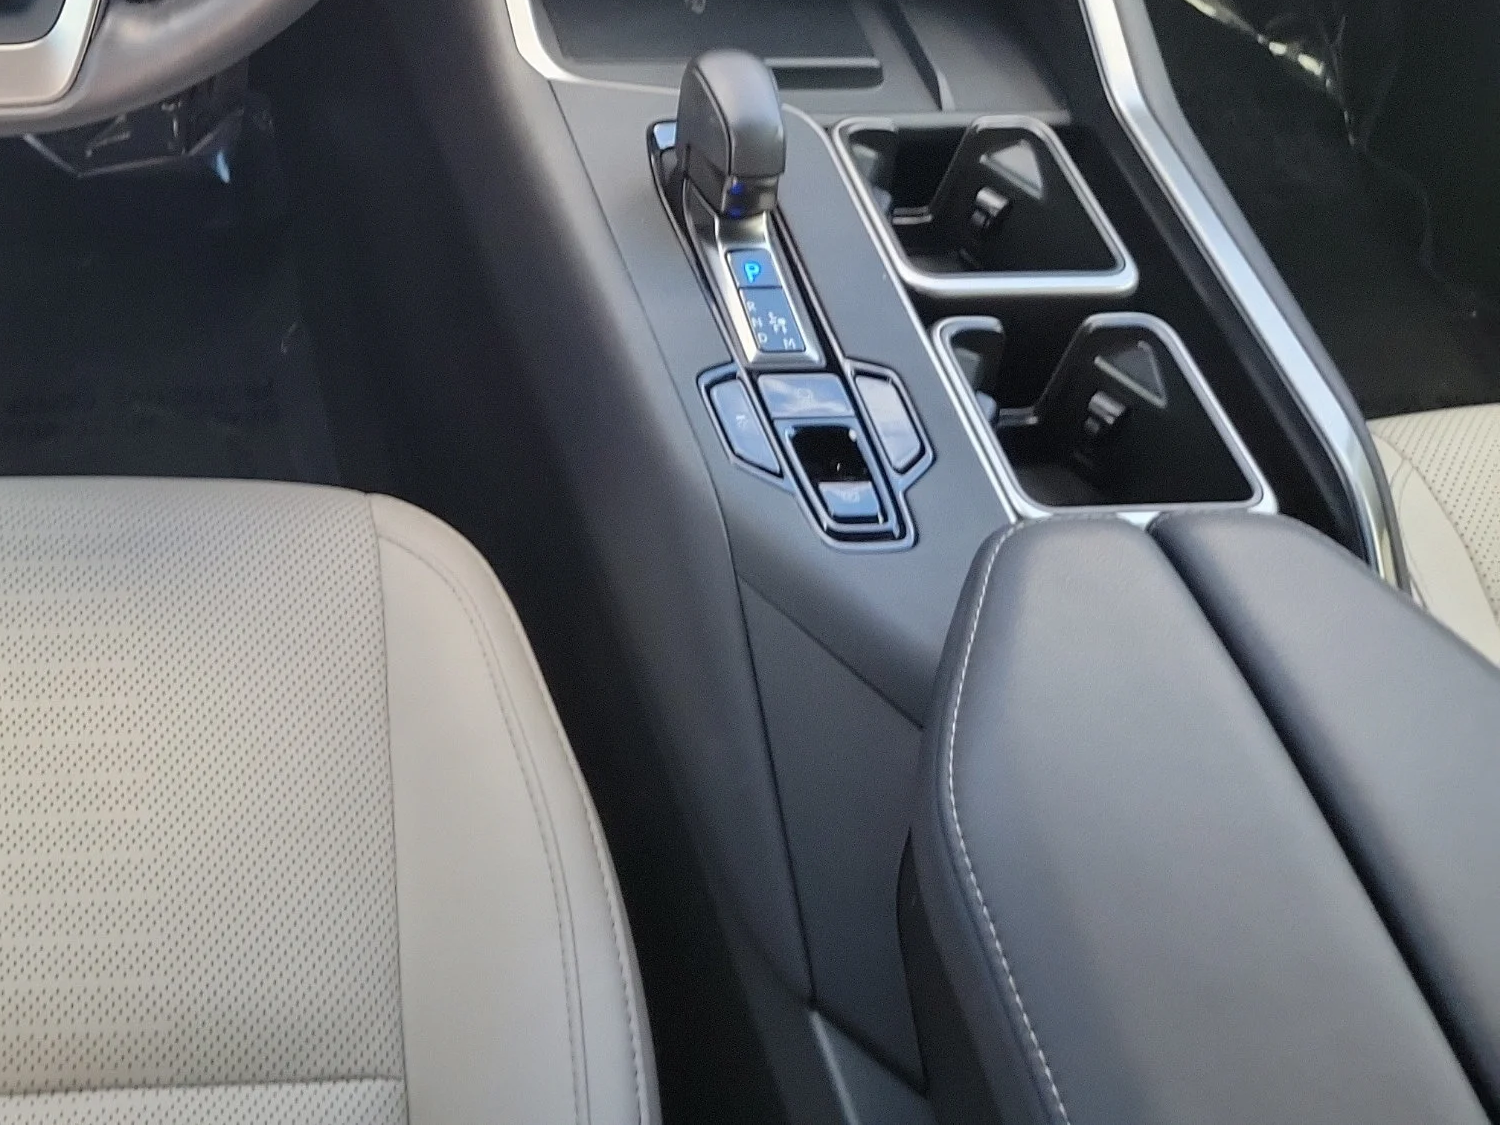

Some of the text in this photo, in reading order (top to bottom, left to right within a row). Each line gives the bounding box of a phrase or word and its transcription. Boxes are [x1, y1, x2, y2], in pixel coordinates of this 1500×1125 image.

[743, 261, 761, 282] P
[746, 300, 757, 312] R
[757, 332, 768, 344] D
[783, 336, 797, 350] M
